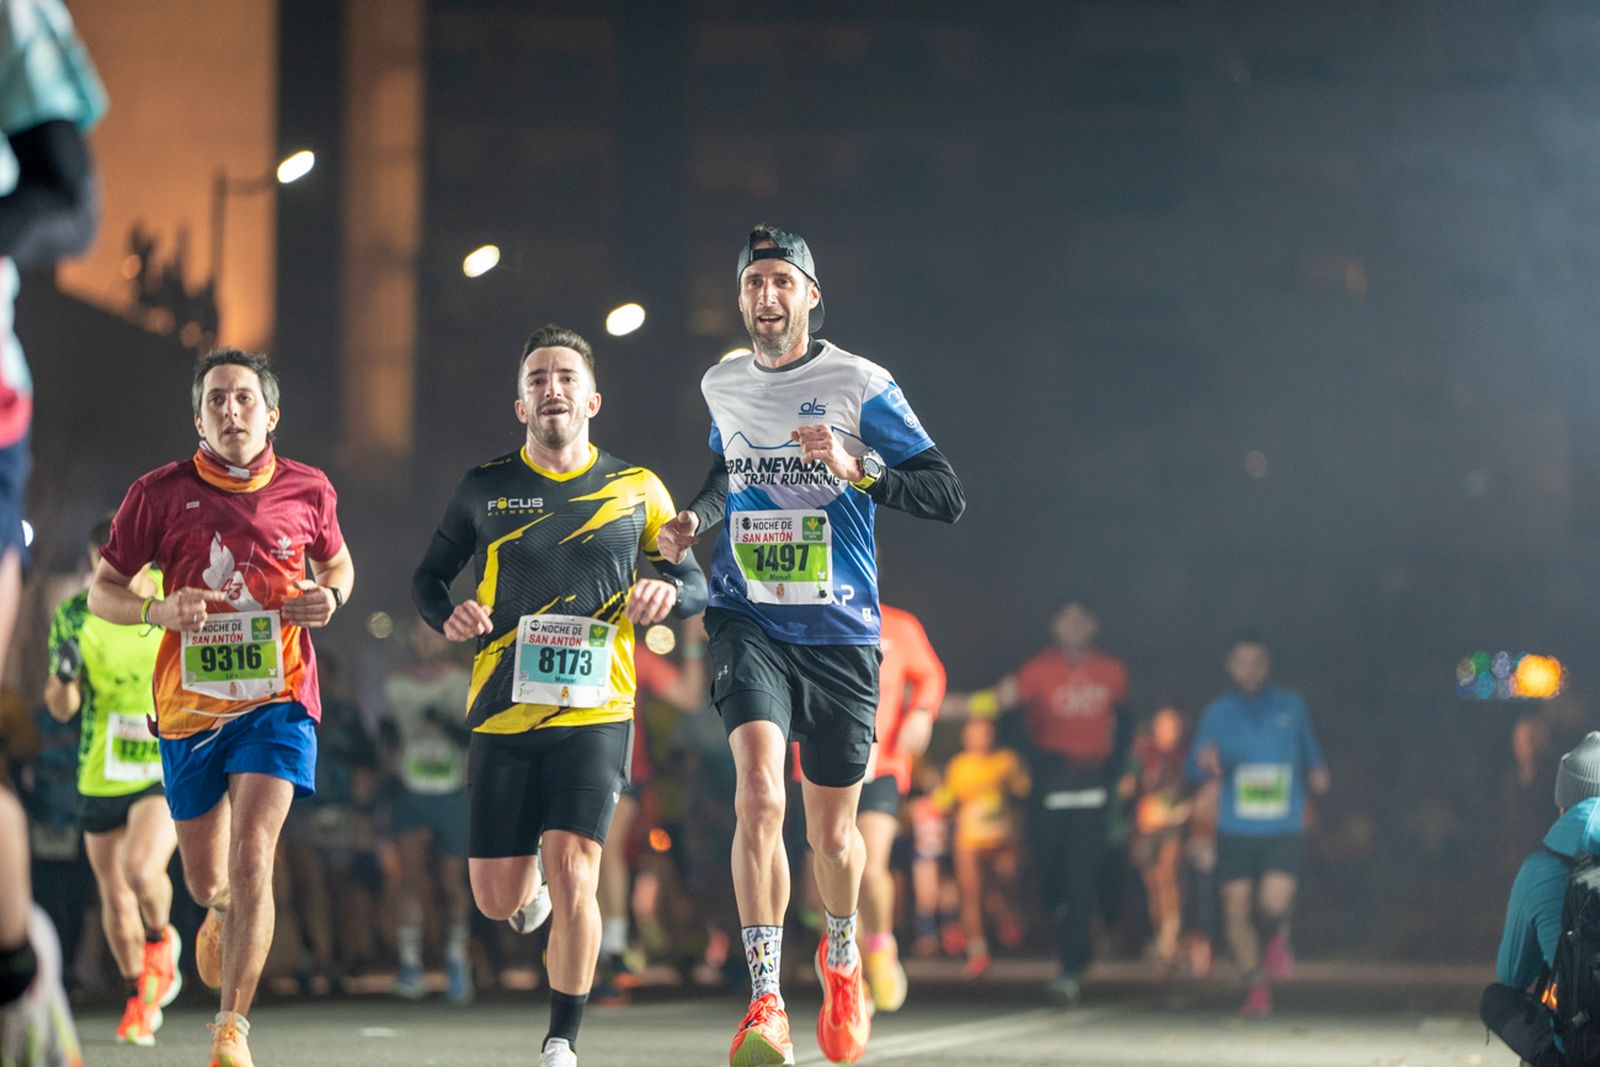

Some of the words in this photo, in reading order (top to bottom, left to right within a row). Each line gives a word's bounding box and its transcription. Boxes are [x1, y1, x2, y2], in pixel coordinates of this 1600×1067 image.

[744, 473, 777, 485] TRAIL
[780, 474, 840, 486] RUNNING
[487, 497, 544, 511] FOCUS
[752, 521, 779, 531] NOCHE
[781, 520, 793, 530] DE
[742, 532, 761, 543] SAN
[762, 529, 793, 542] ANTÓN
[753, 544, 810, 572] 1497
[202, 622, 230, 634] NOCHE
[231, 622, 243, 632] DE
[541, 624, 570, 635] NOCHE
[572, 626, 583, 635] DE
[191, 635, 210, 645] SAN
[211, 633, 243, 644] ANTÓN
[528, 634, 549, 644] SAN
[550, 635, 583, 647] ANTÓN
[200, 643, 262, 672] 9316
[538, 646, 593, 676] 8173
